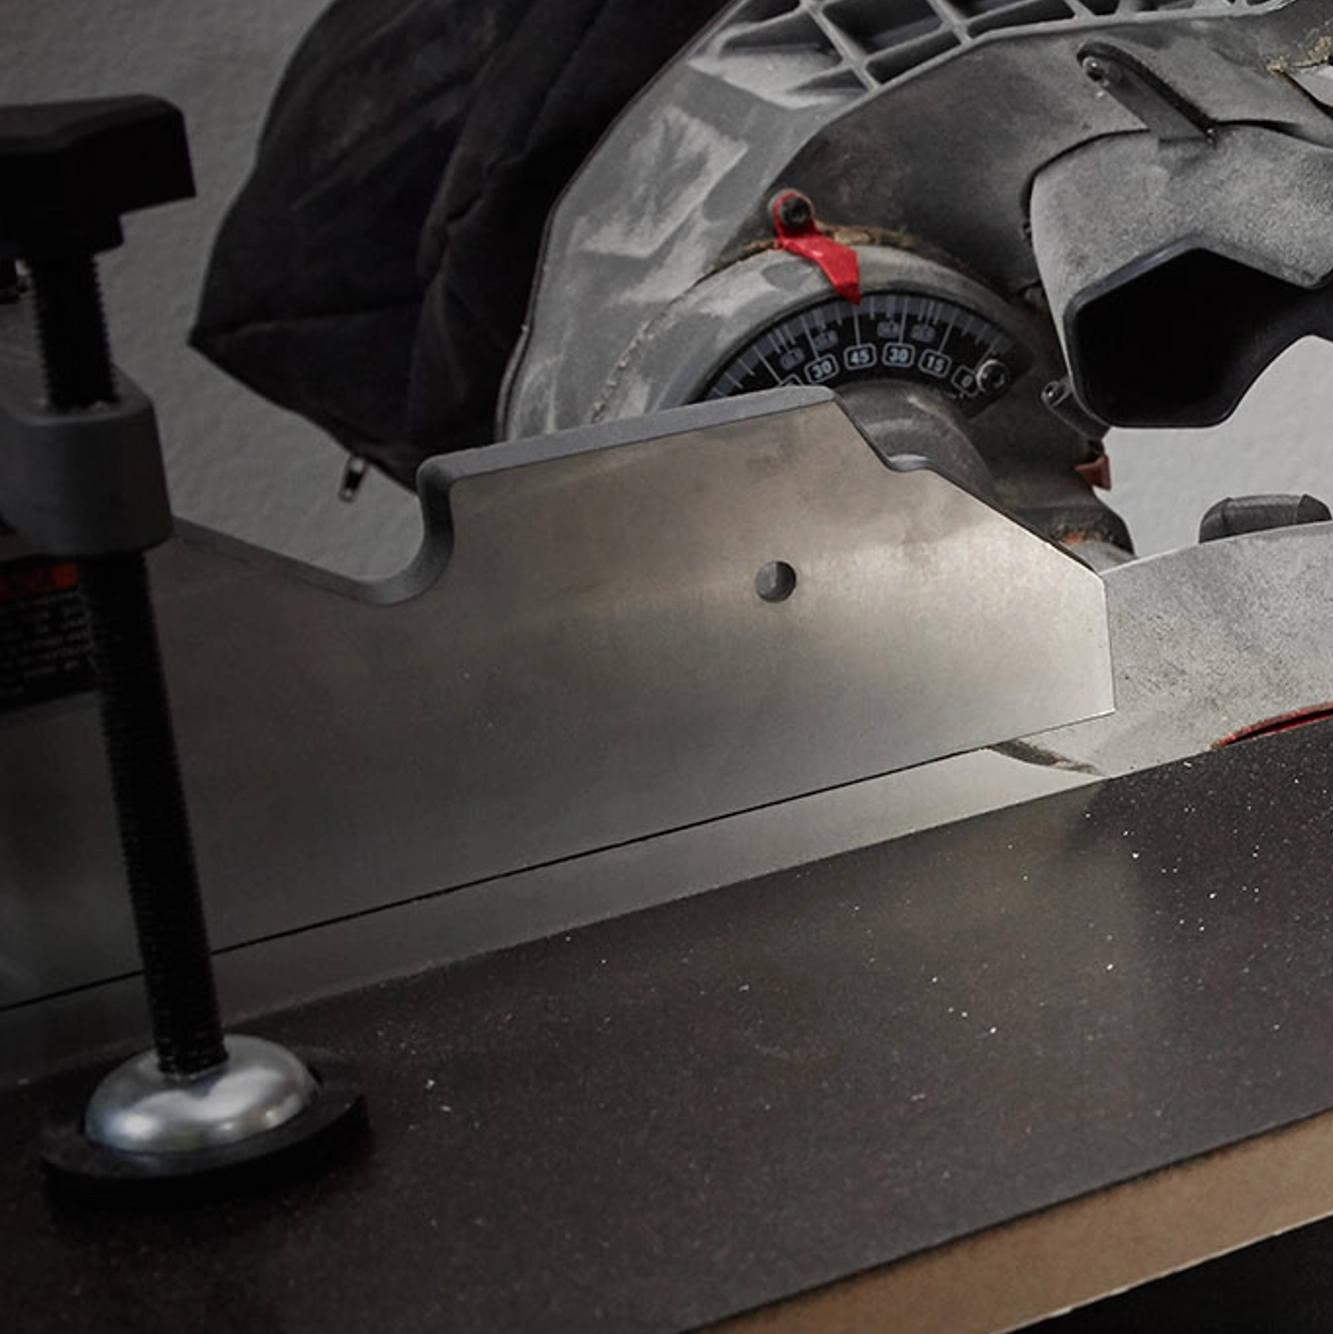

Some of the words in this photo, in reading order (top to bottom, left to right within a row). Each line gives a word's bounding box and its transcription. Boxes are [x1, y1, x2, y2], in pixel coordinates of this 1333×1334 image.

[849, 349, 871, 365] 45
[887, 347, 909, 362] 30
[811, 359, 833, 378] 30
[925, 355, 945, 372] 15
